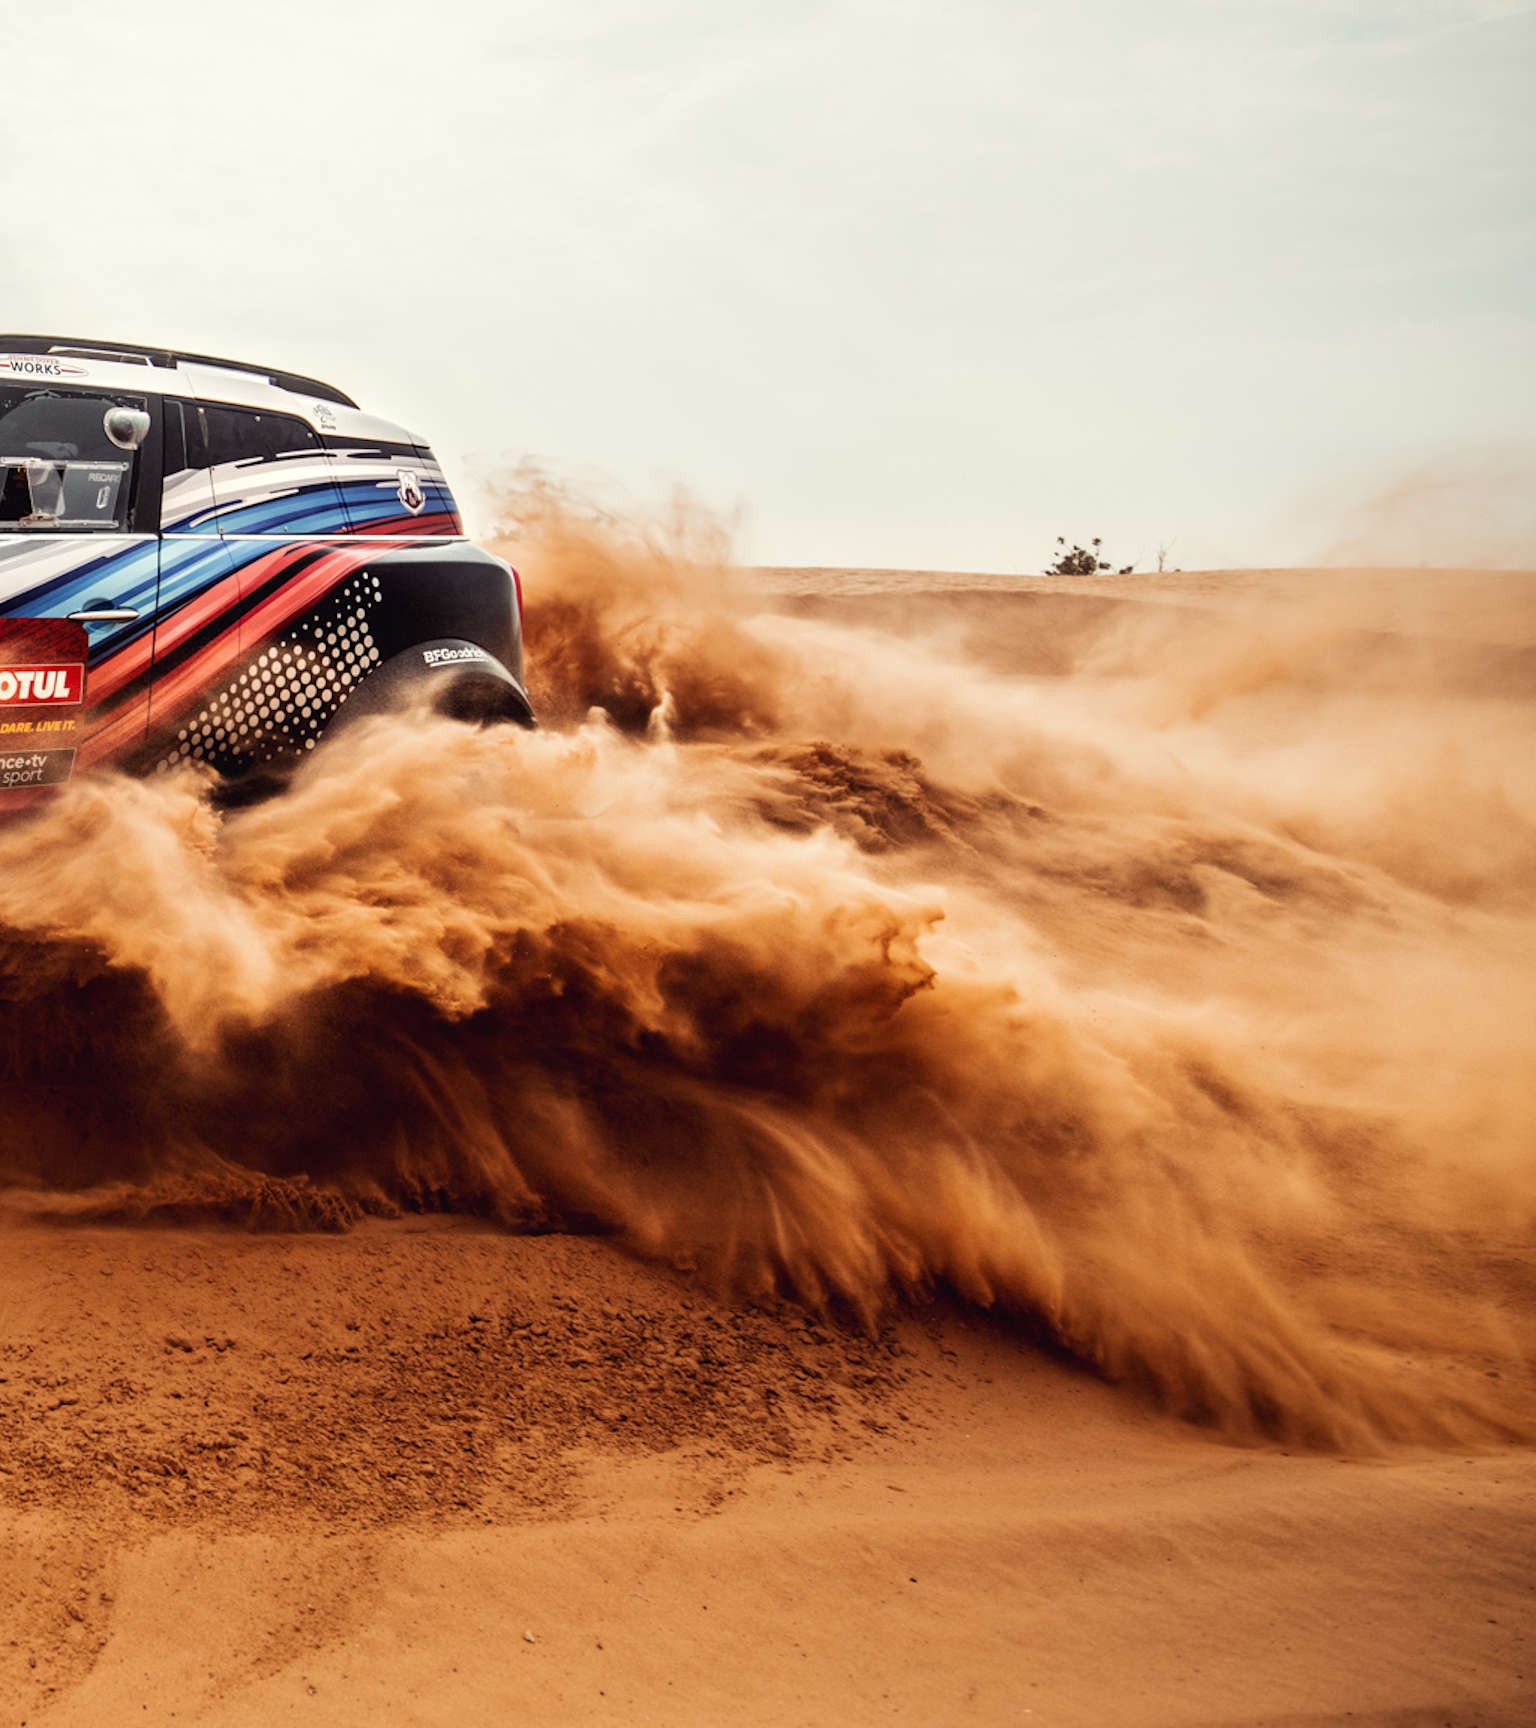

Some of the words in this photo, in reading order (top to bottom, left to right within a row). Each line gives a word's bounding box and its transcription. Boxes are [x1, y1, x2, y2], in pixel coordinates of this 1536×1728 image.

[10, 361, 62, 375] WORKS
[0, 722, 34, 735] DARE.
[36, 720, 61, 732] LIVE
[2, 768, 44, 787] sport
